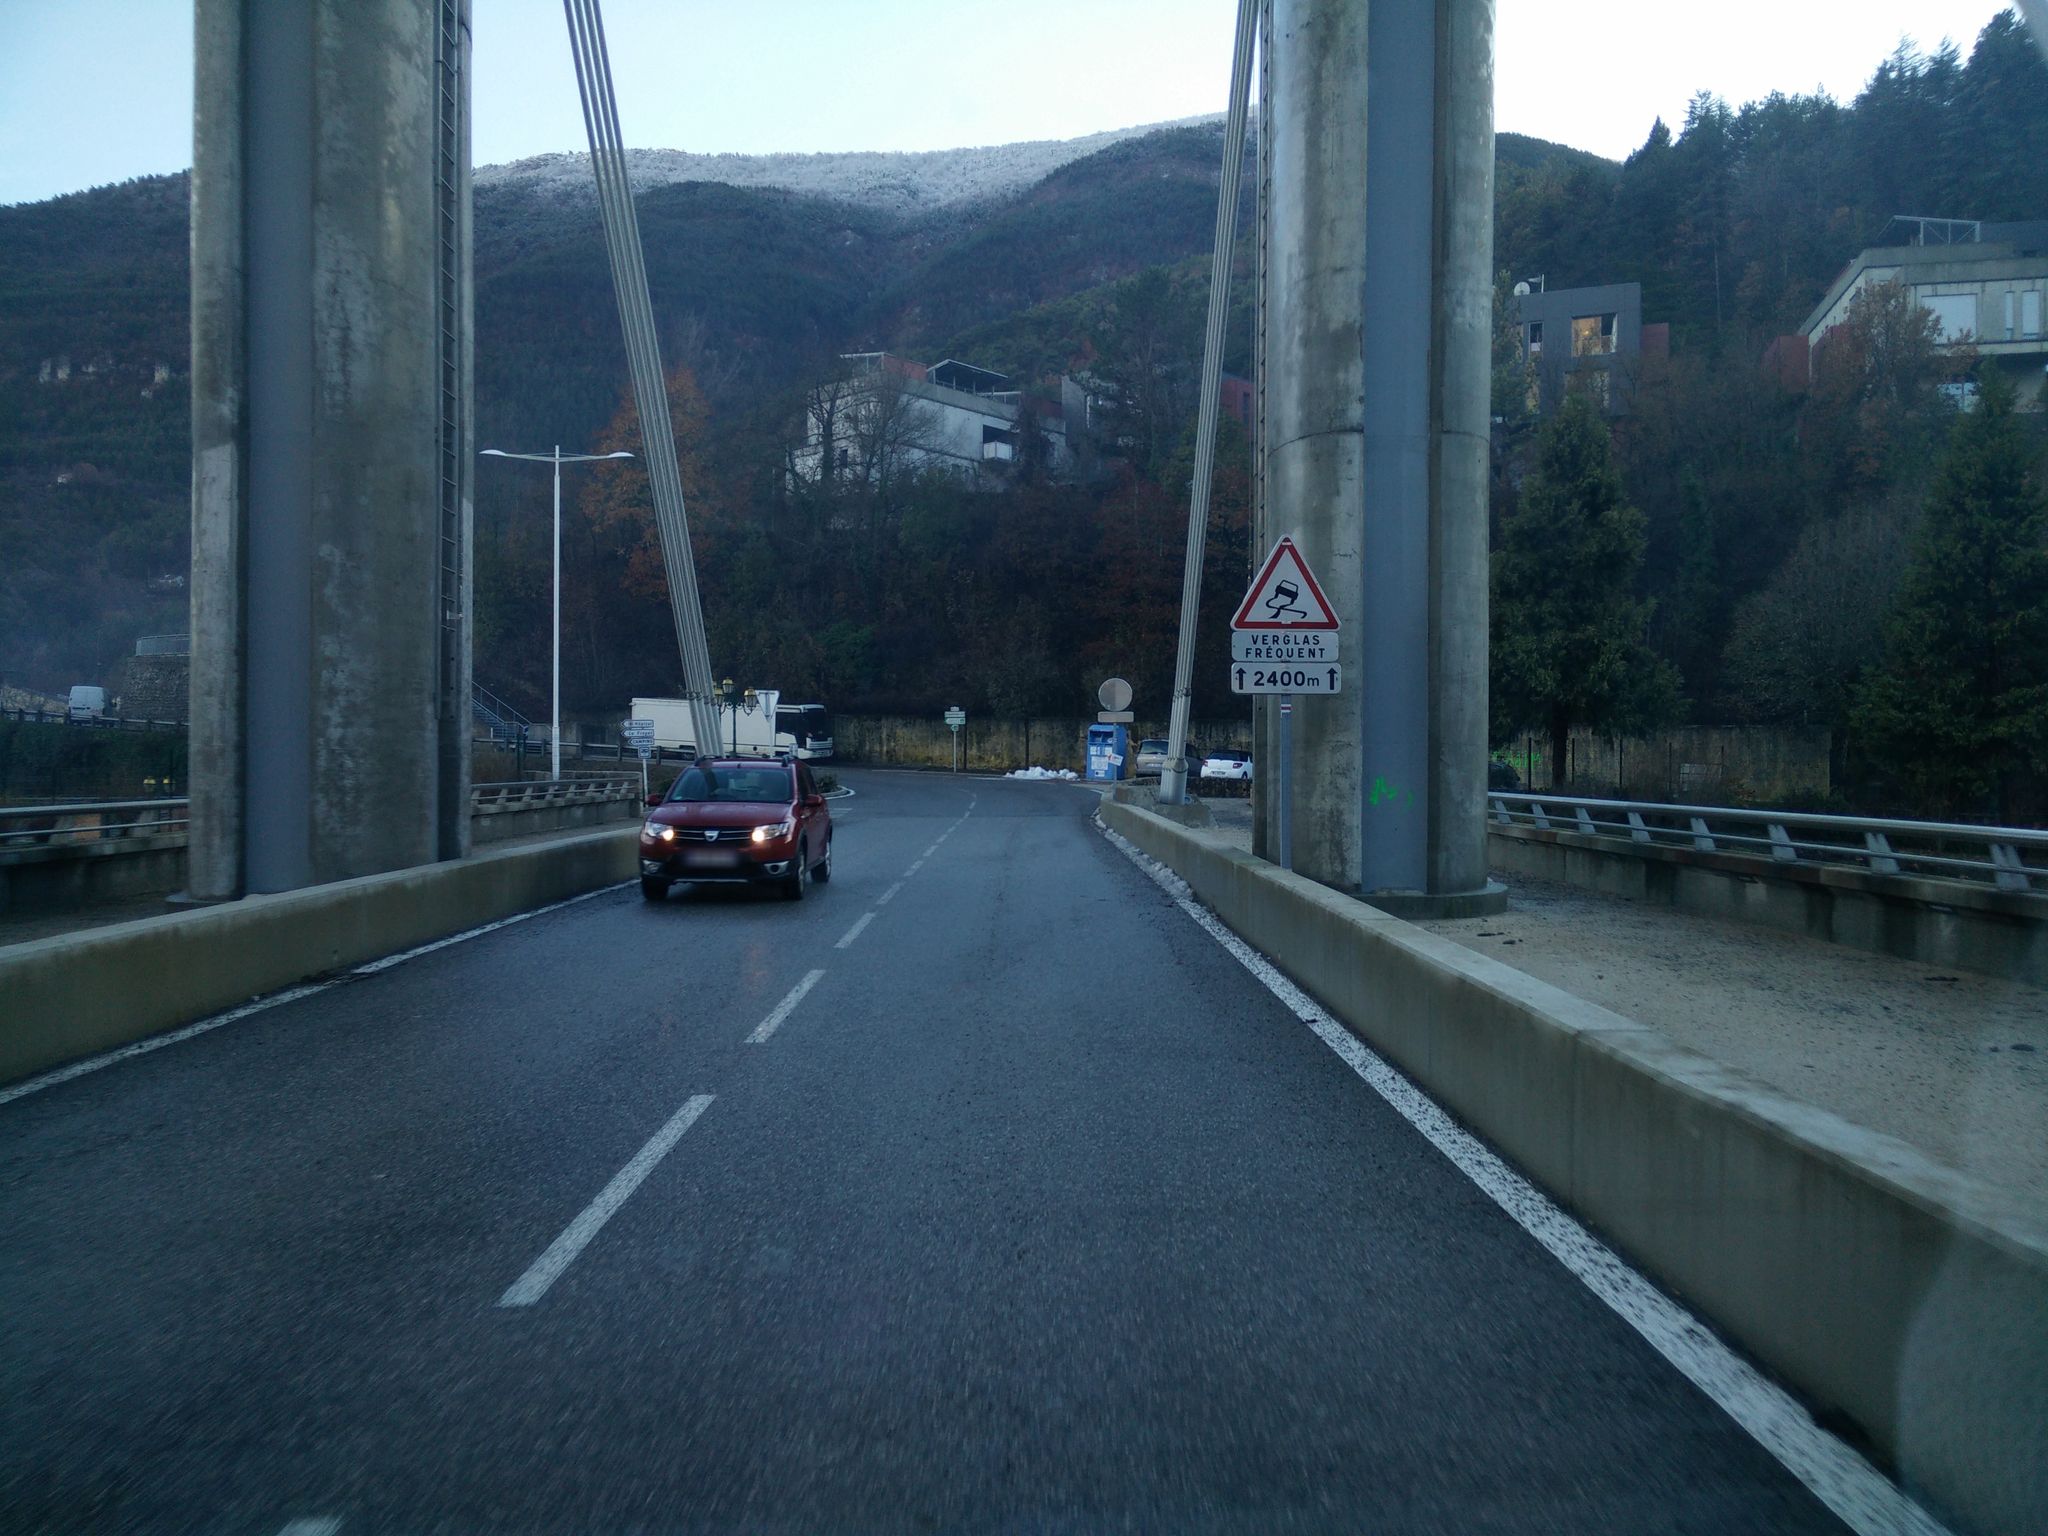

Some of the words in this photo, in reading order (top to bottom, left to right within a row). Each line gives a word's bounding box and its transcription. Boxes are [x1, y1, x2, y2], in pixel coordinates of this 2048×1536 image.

[1251, 634, 1320, 645] VERGLAS
[1245, 646, 1325, 658] FRÉQUENT
[1254, 671, 1320, 686] 2400m
